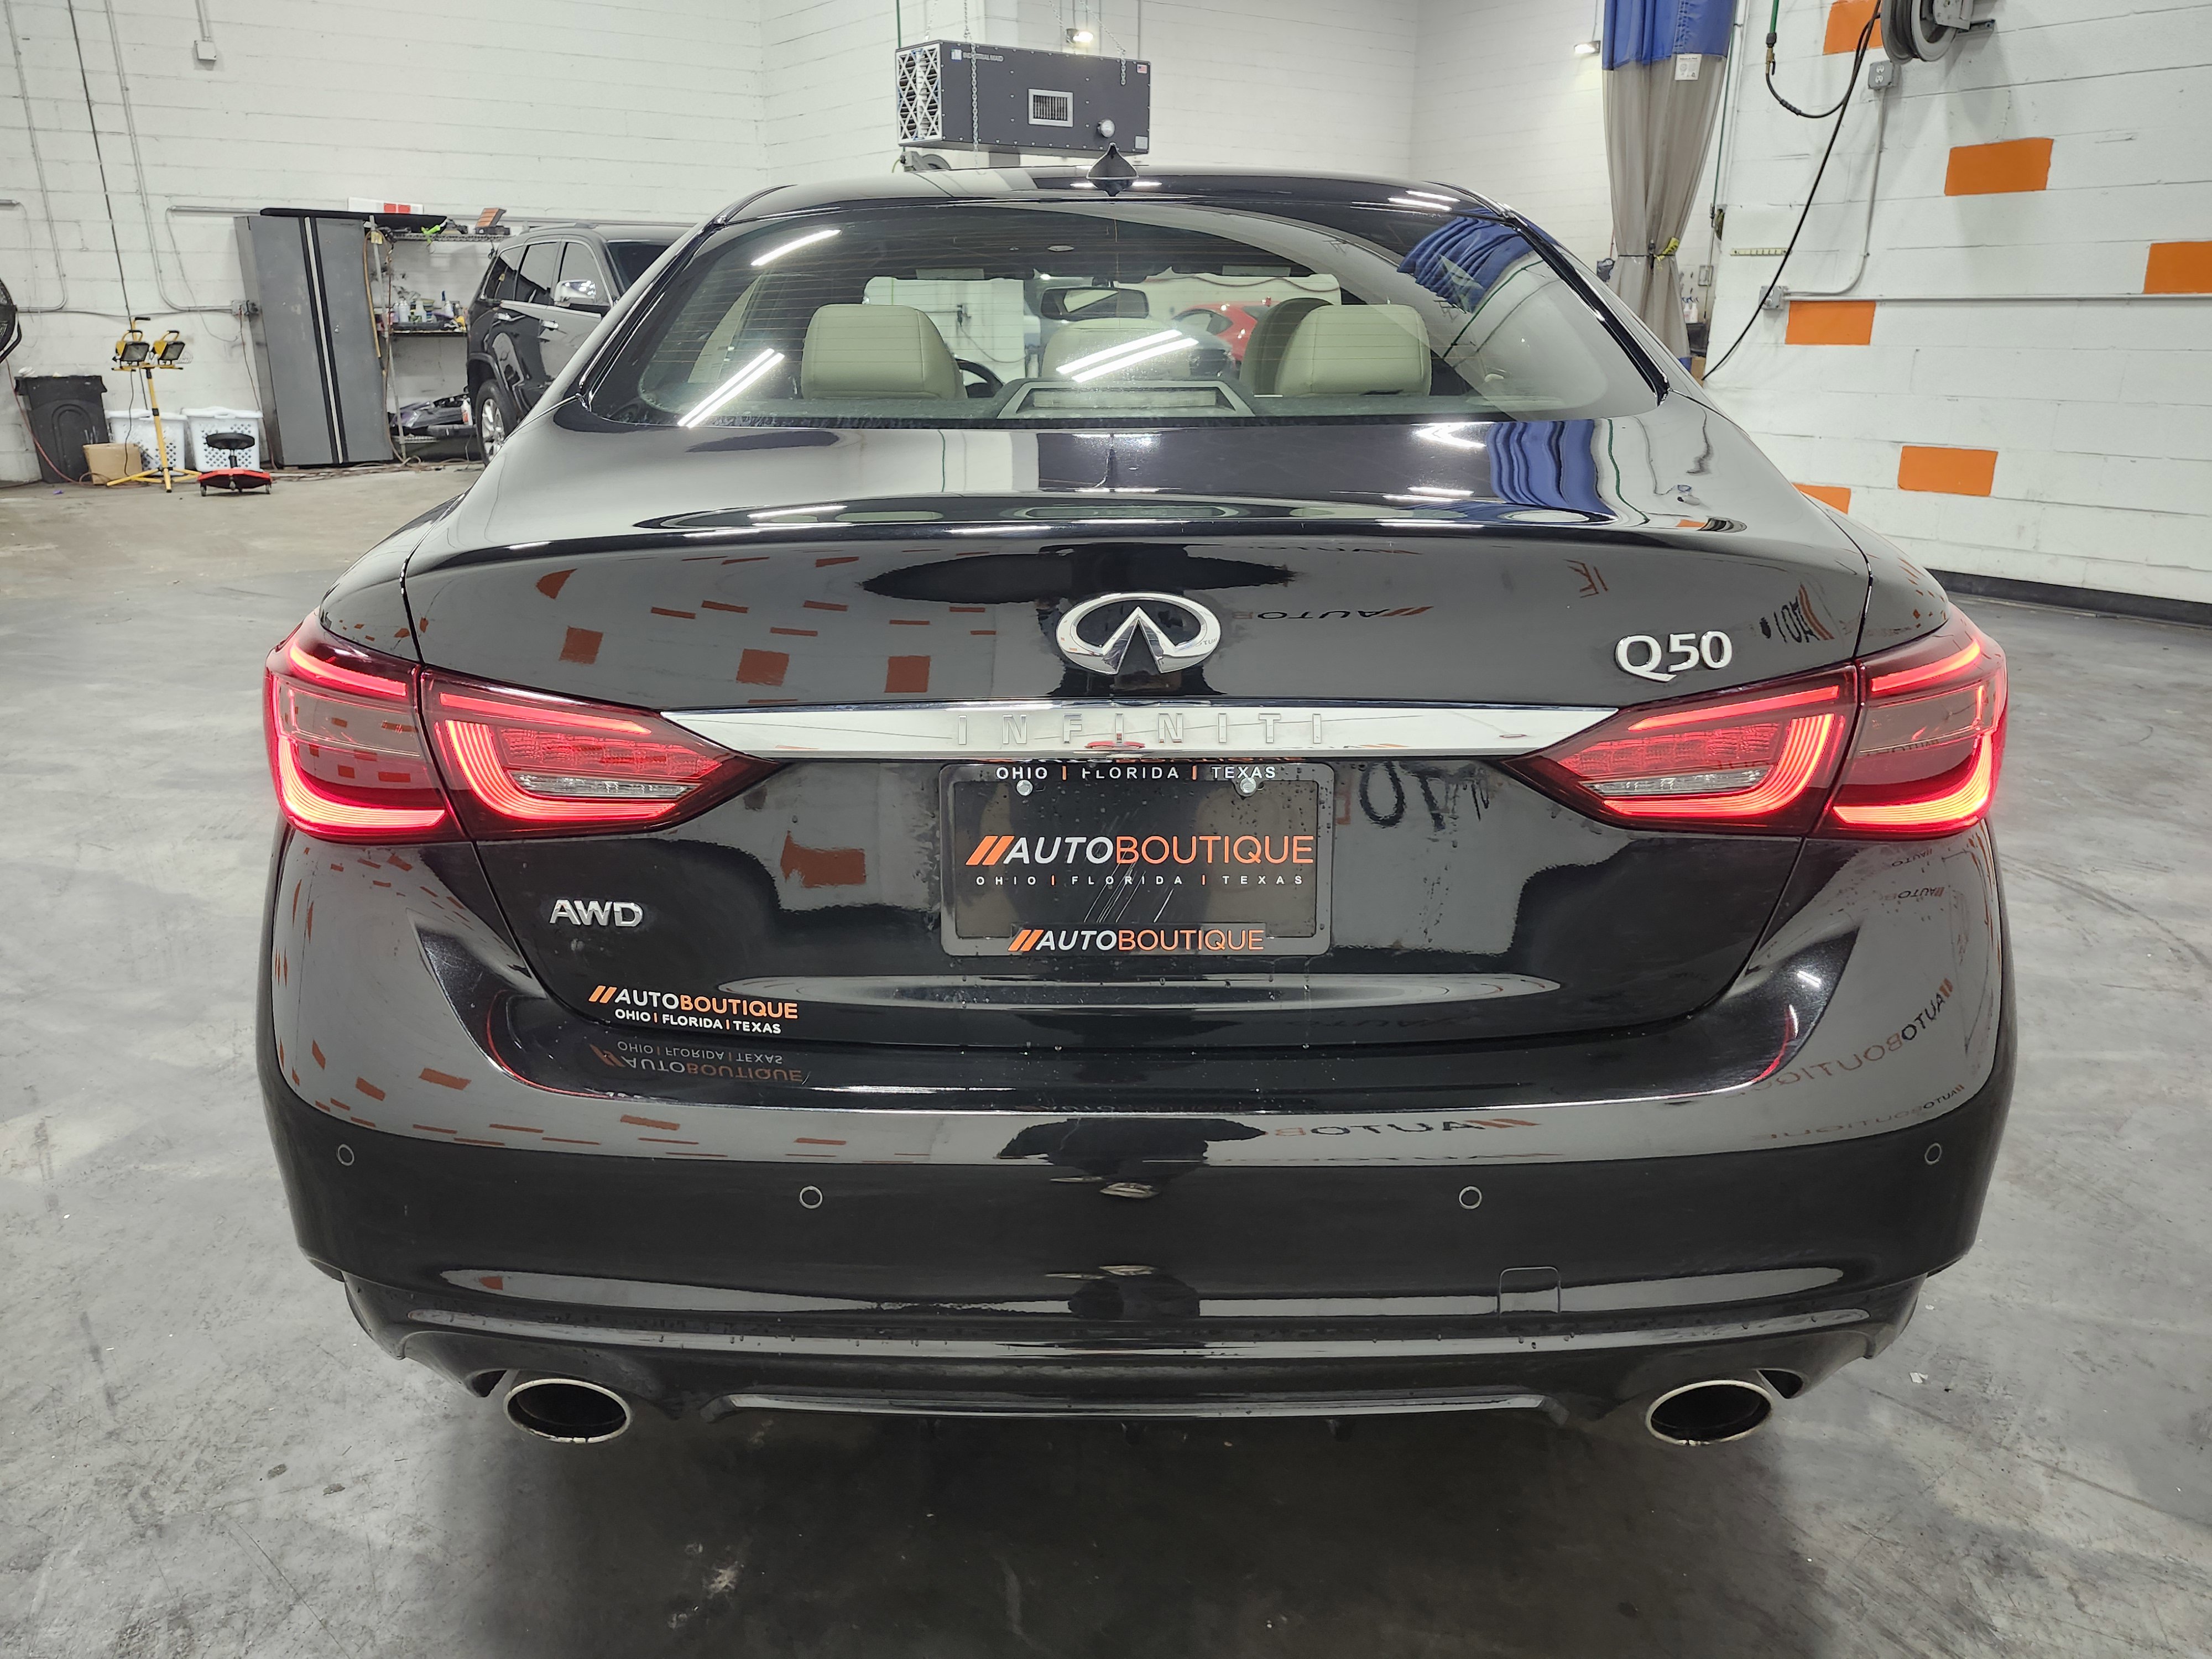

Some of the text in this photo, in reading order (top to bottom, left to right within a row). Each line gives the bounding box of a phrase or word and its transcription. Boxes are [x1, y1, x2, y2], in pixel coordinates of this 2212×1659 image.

[1615, 630, 1733, 682] Q50
[958, 713, 1322, 745] INFINITI
[996, 766, 1276, 779] OHIO FLORIDA TEXAS
[1003, 836, 1314, 864] AUTOBOUTIQUE
[976, 875, 1303, 886] OHIO FLORIDA TEXAS
[549, 899, 644, 927] AWD
[1036, 929, 1265, 951] AUTOBOUTIQUE
[614, 989, 799, 1019] AUTOBOUTIQUE
[614, 1009, 781, 1034] OHIO FLORIDA TEXAS
